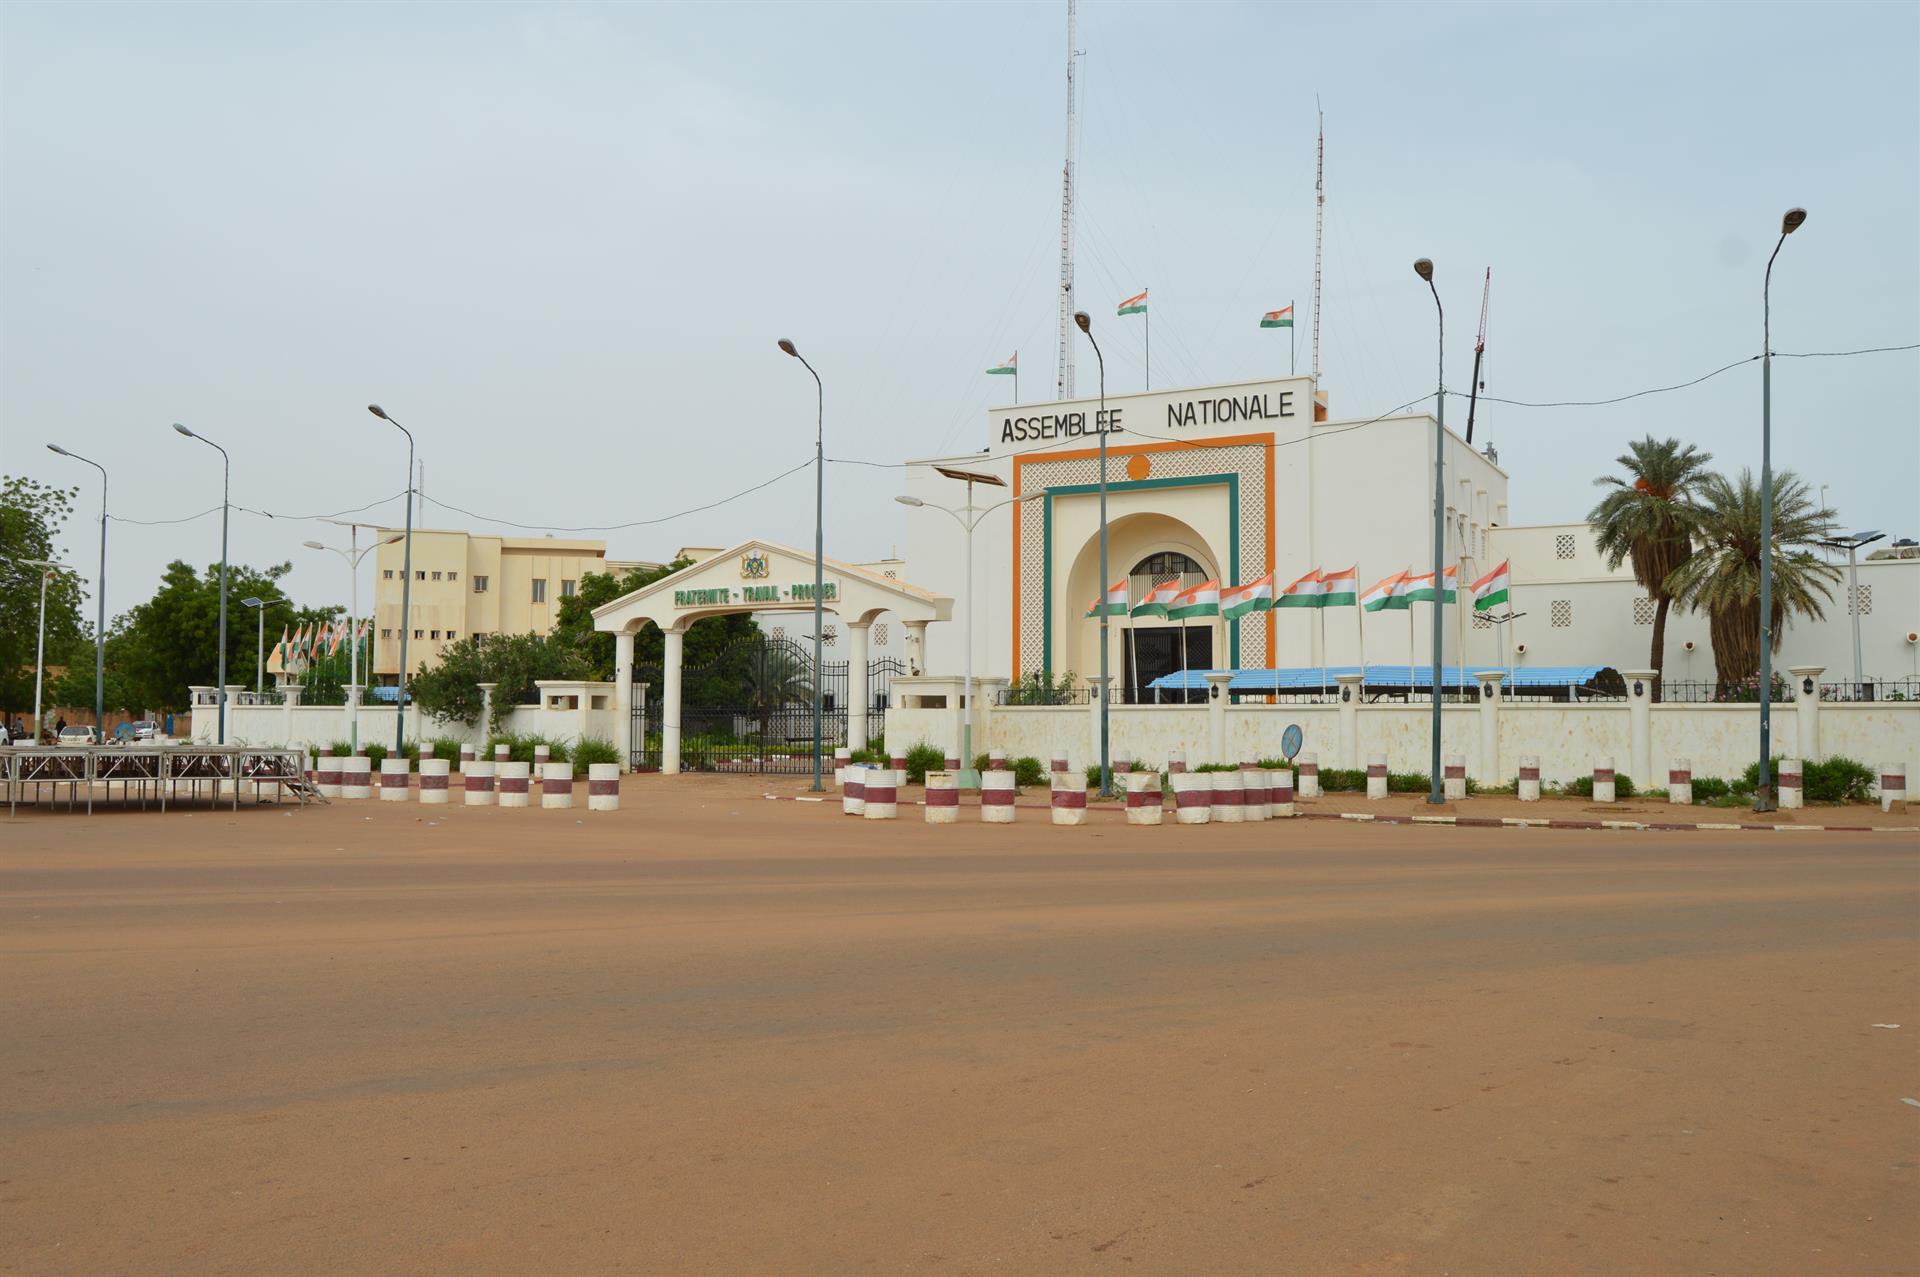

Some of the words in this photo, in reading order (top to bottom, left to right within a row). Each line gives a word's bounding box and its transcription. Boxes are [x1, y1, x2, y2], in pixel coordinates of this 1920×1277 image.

[1001, 409, 1123, 443] ASSEMBLEE
[1168, 391, 1295, 428] NATIONALE
[674, 588, 729, 606] FRATERNITE
[742, 586, 781, 603] TRAVAIL
[791, 583, 837, 600] PROGES
